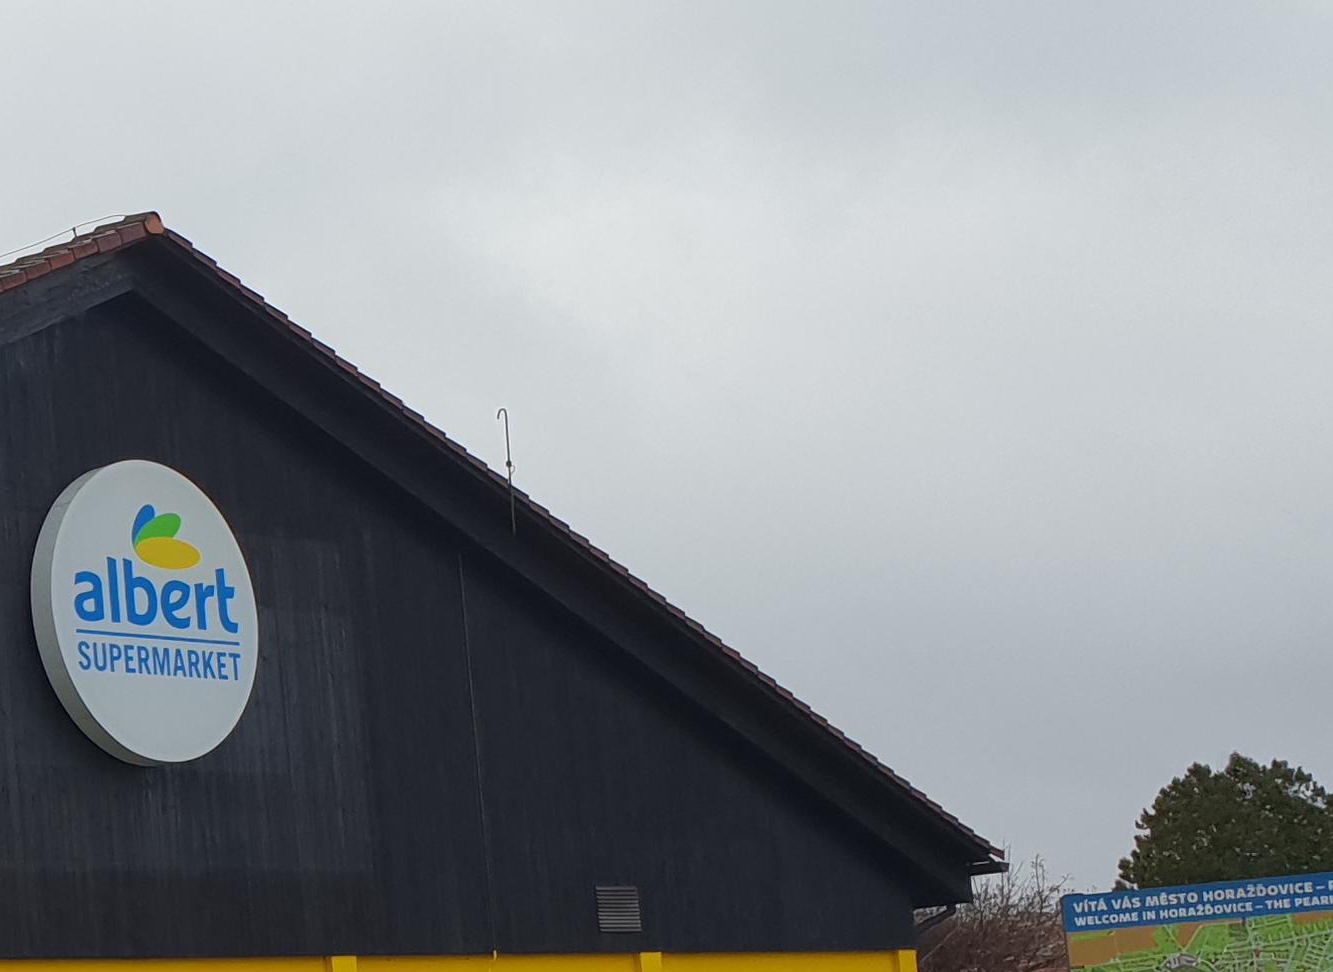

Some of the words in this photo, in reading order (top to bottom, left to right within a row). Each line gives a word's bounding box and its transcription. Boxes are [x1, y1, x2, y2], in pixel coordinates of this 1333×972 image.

[74, 556, 239, 634] albert
[77, 640, 241, 681] SUPERMARKET
[1073, 897, 1108, 913] VÍTÁ
[1111, 895, 1141, 910] VÁS
[1145, 892, 1199, 907] MĚSTO
[1202, 881, 1313, 902] HORAŽĎOVICE
[1074, 912, 1139, 926] WELCOME
[1142, 910, 1156, 921] IN
[1159, 901, 1253, 920] HORAŽĎOVICE
[1265, 898, 1291, 910] THE
